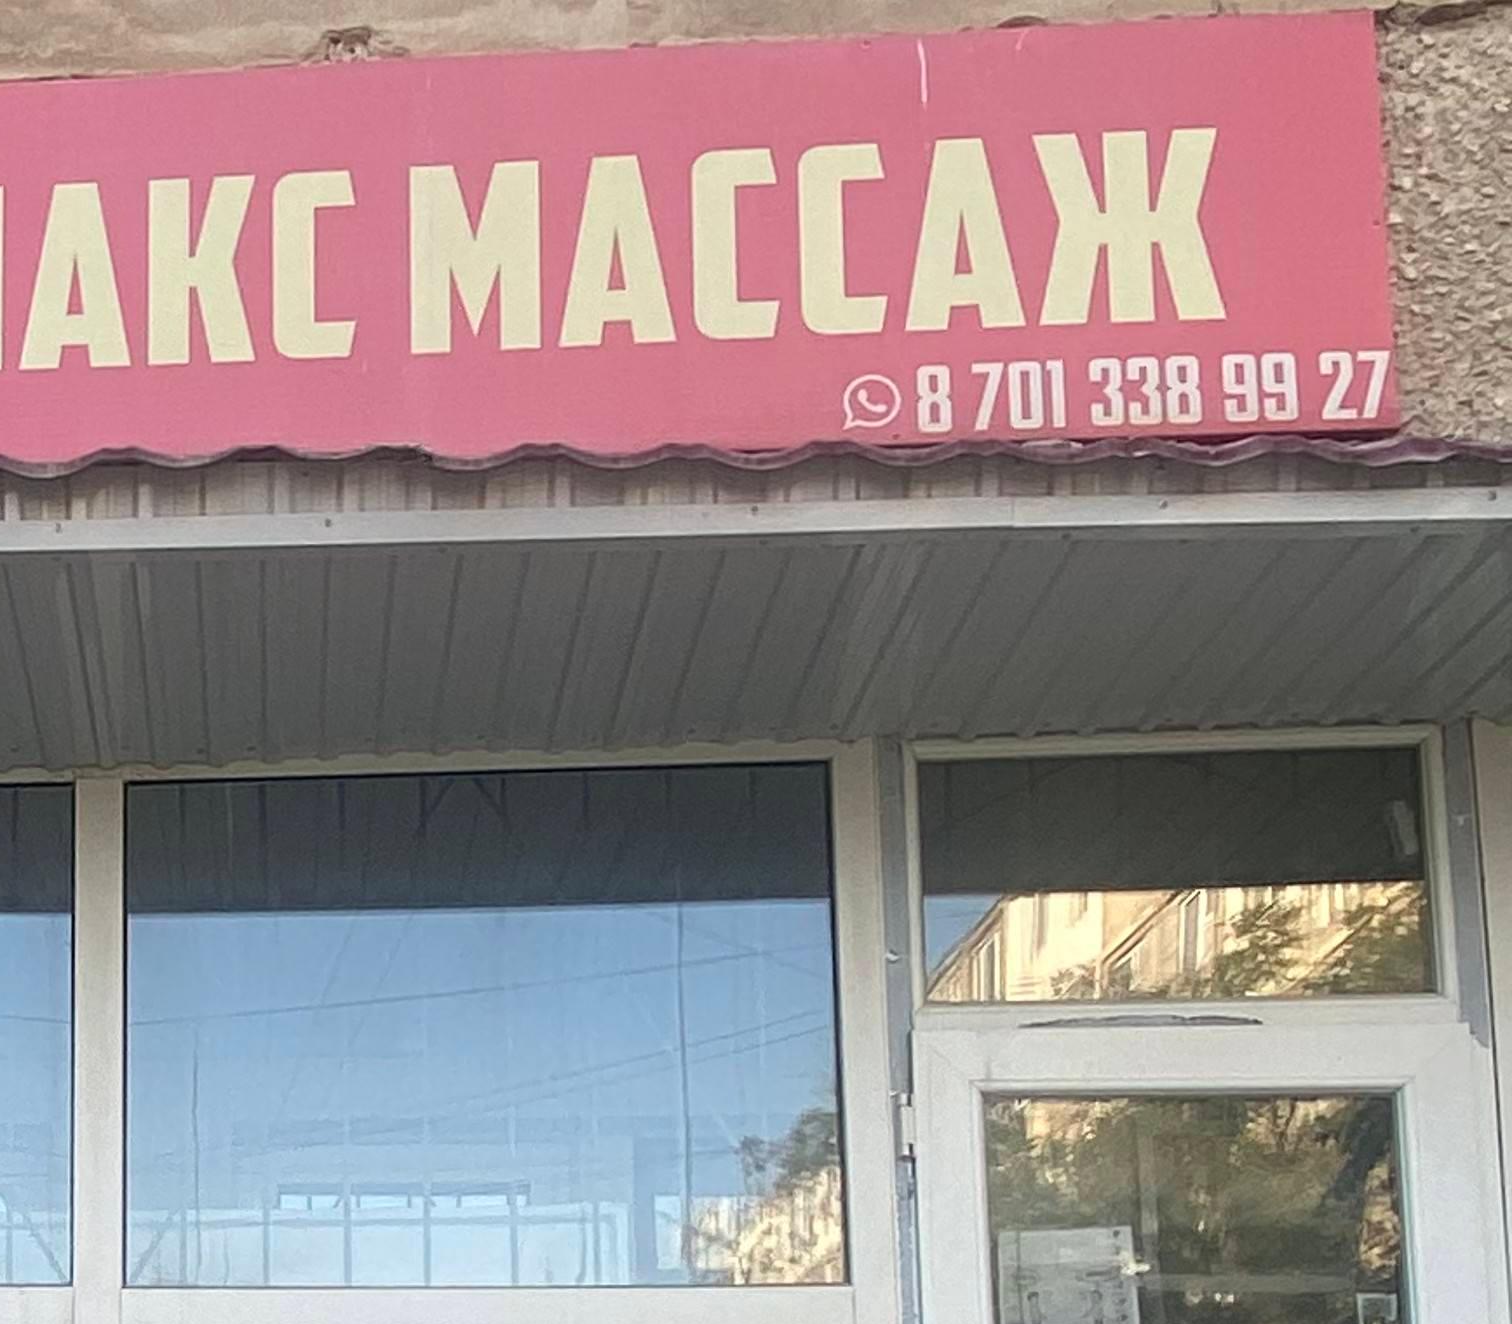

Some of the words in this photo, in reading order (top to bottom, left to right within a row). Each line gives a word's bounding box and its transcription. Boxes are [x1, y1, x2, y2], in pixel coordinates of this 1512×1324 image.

[409, 127, 1227, 354] МАССАЖ
[916, 364, 953, 433] 8
[972, 359, 1066, 430] 701
[1088, 355, 1202, 426] 338
[1222, 353, 1299, 422] 99
[1319, 350, 1390, 420] 27
